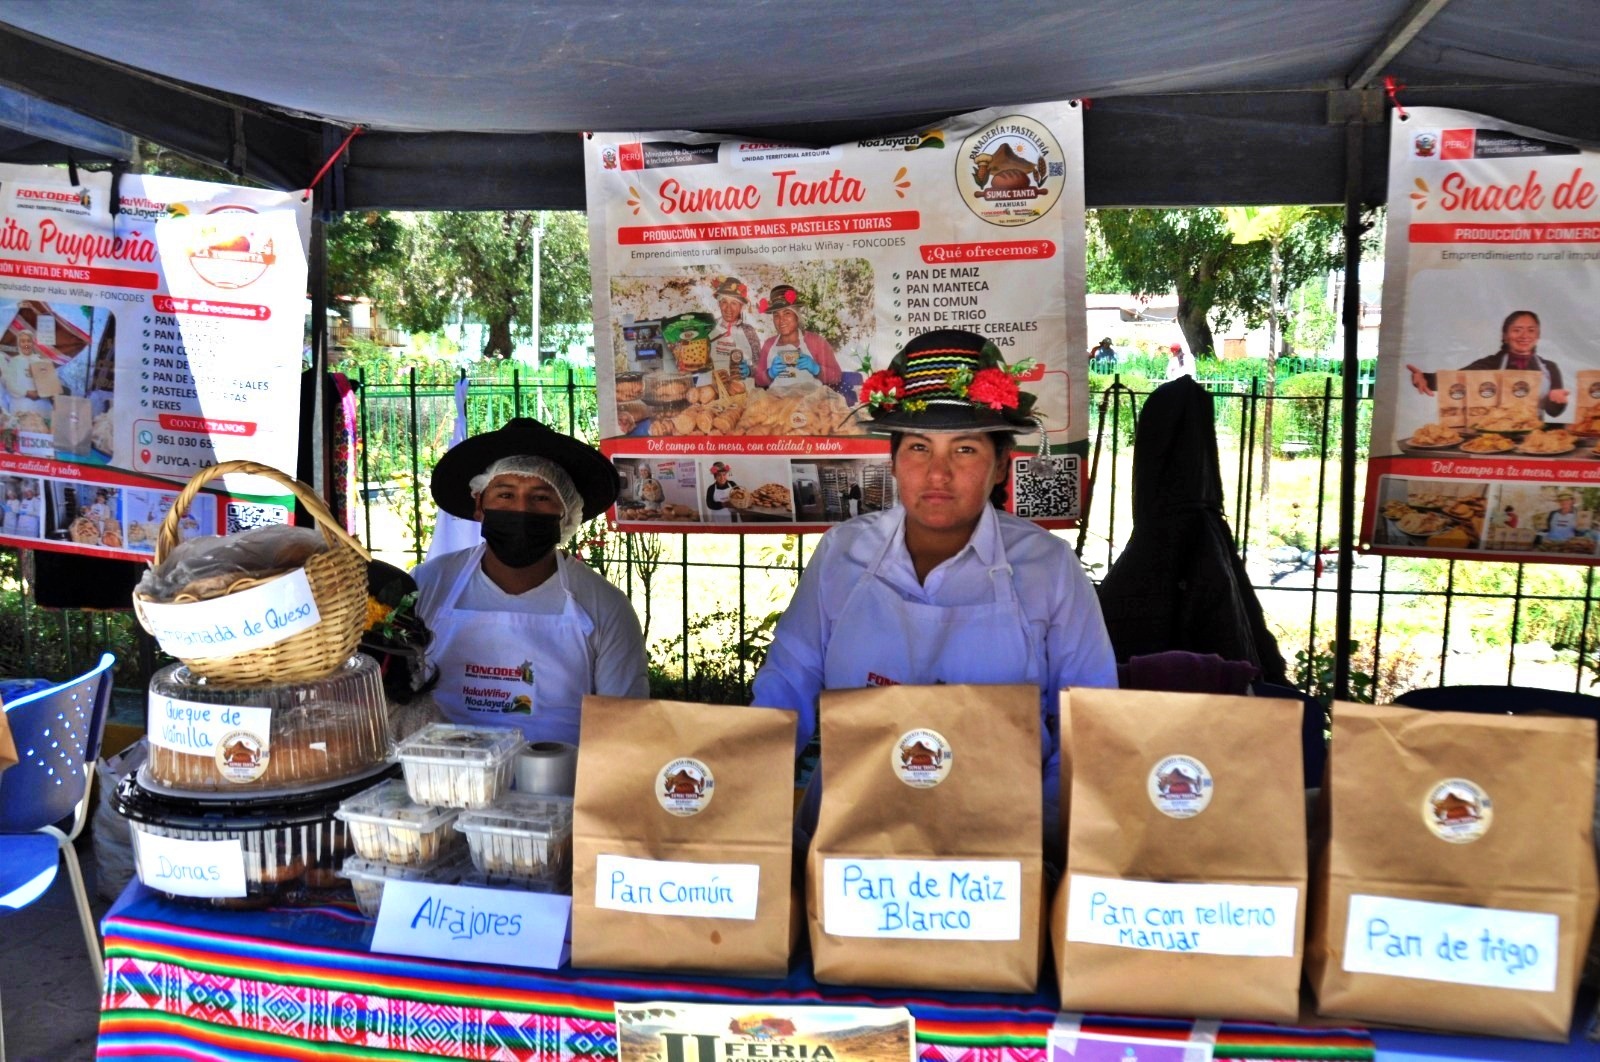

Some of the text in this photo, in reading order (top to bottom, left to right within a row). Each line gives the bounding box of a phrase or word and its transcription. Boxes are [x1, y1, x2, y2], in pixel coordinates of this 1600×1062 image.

[969, 125, 1006, 159] PANADERÍA
[1011, 125, 1049, 156] PASTELERÍA
[621, 152, 641, 161] PERÚ
[651, 156, 675, 165] Inclusión
[675, 154, 693, 163] Social
[742, 150, 830, 162] UNIDAD TERRITORIAL AREQUIPA
[16, 188, 81, 204] FONCODES
[659, 168, 866, 214] Sumac Tanta
[987, 189, 1036, 199] SUMAC TANTA
[1440, 167, 1598, 211] Snack de
[643, 217, 892, 241] PRODUCCIÓN Y VENTA DE PANES, PASTELES Y TORTAS
[1454, 227, 1531, 240] PRODUCCIÓN
[1534, 228, 1543, 240] Y
[39, 218, 157, 265] Puyqueña
[631, 248, 700, 260] Emprendimiento
[702, 247, 722, 256] rural
[723, 244, 770, 257] impulsado
[772, 245, 788, 254] por
[789, 243, 812, 252] Haku
[815, 241, 844, 252] Wiñay
[853, 237, 906, 248] FONCODES
[927, 246, 962, 261] ¿Qué
[966, 244, 1039, 258] ofrecemos
[1442, 250, 1534, 262] Emprendimiento
[1537, 250, 1564, 260] rural
[23, 265, 48, 276] VENTA
[51, 267, 61, 278] DE
[63, 268, 90, 280] PANES
[906, 267, 980, 280] PAN DE MAIZ
[33, 286, 46, 295] por
[100, 291, 145, 302] FONCODES
[906, 281, 989, 294] PAN MANTECA
[907, 296, 978, 308] PAN COMUN
[155, 315, 175, 327] PAN
[908, 309, 987, 322] PAN DE TRIGO
[154, 330, 175, 341] PAN
[908, 326, 931, 336] PAN
[984, 321, 1038, 334] CEREALES
[154, 344, 174, 355] PAN
[153, 358, 174, 369] PAN
[176, 359, 189, 370] DE
[153, 372, 174, 383] PAN
[175, 374, 188, 384] DE
[152, 386, 198, 399] PASTELES
[152, 400, 182, 411] KEKES
[157, 434, 175, 446] 961
[178, 437, 197, 447] 030
[648, 440, 663, 451] Del
[666, 443, 695, 453] campo
[706, 441, 716, 451] tu
[718, 443, 744, 452] mesa,
[747, 443, 764, 451] con
[766, 440, 804, 451] calidad
[806, 443, 813, 454] y
[815, 441, 842, 451] sabor
[156, 455, 190, 467] PUYCA
[1431, 461, 1454, 474] Del
[1455, 466, 1493, 477] campo
[243, 620, 262, 636] de
[265, 602, 311, 628] Queso
[465, 664, 522, 677] FONCODES
[165, 701, 241, 726] Queque de
[156, 855, 220, 881] Donas
[611, 871, 652, 904] Pan
[842, 864, 1006, 902] Pan de Maiz
[1090, 892, 1136, 926] Pan
[1196, 901, 1276, 926] relleno
[878, 902, 971, 931] Blanco
[1366, 918, 1538, 975] Pan de trigo
[725, 1042, 835, 1060] FERIA
